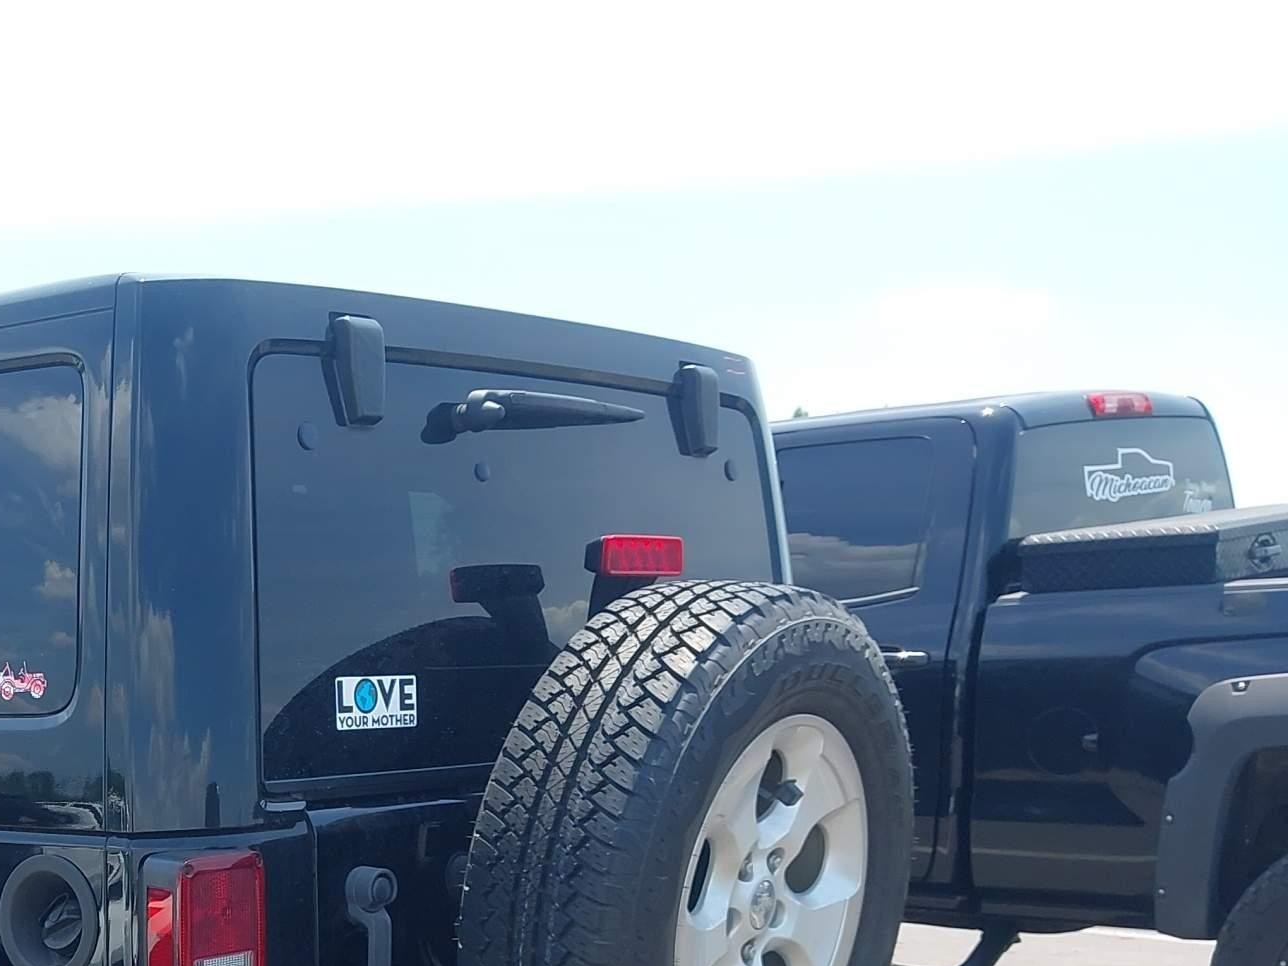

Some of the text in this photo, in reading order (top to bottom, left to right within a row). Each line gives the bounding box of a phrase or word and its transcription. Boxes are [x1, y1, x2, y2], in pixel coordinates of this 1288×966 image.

[1089, 471, 1175, 502] Michoacan
[337, 678, 415, 714] LOVE
[338, 714, 415, 728] YOUR MOTHER
